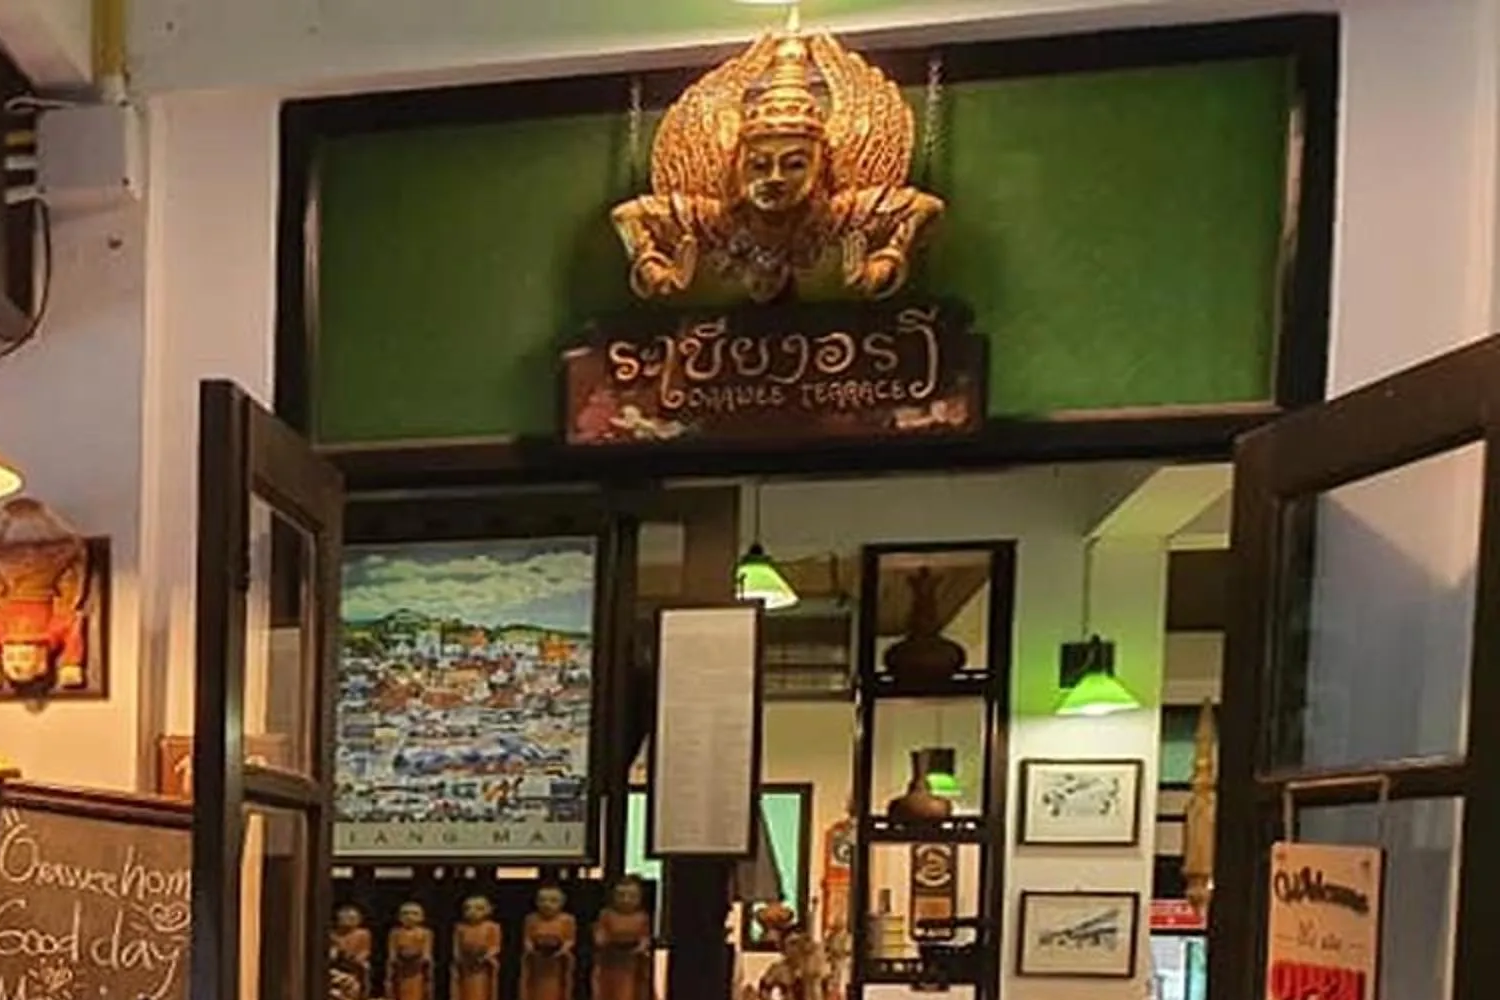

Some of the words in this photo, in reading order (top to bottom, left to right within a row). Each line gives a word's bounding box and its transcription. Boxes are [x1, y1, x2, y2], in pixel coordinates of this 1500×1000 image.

[348, 828, 459, 846] IANG
[492, 828, 572, 846] MAI
[121, 845, 192, 900] hom
[90, 906, 184, 1000] day
